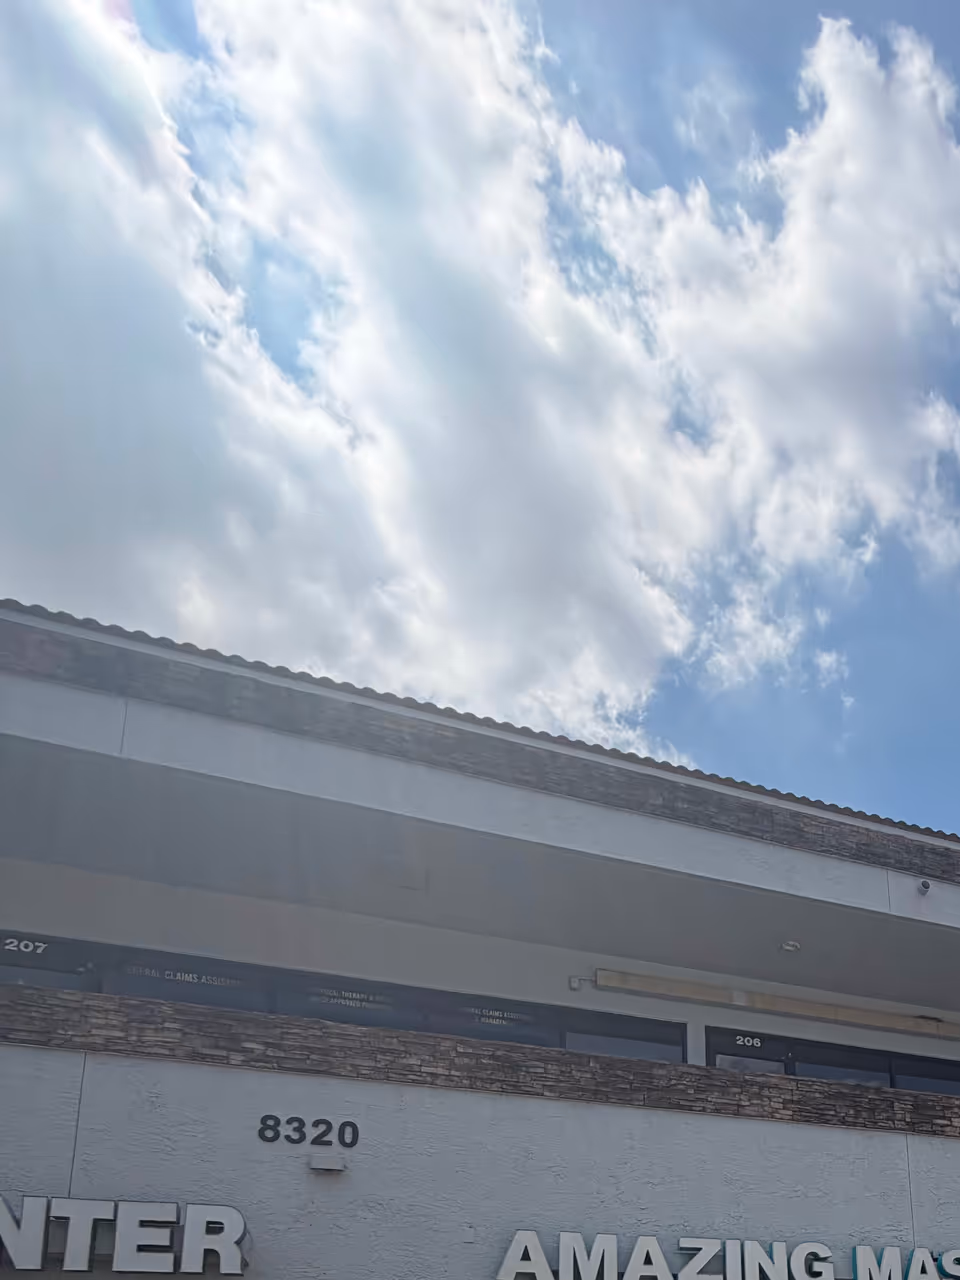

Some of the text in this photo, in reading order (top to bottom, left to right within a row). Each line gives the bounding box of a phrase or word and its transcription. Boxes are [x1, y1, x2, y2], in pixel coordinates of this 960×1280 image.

[3, 938, 48, 954] 207
[164, 970, 199, 984] CLAIMS
[735, 1035, 762, 1047] 206
[258, 1114, 360, 1148] 8320
[0, 1195, 244, 1276] NTER
